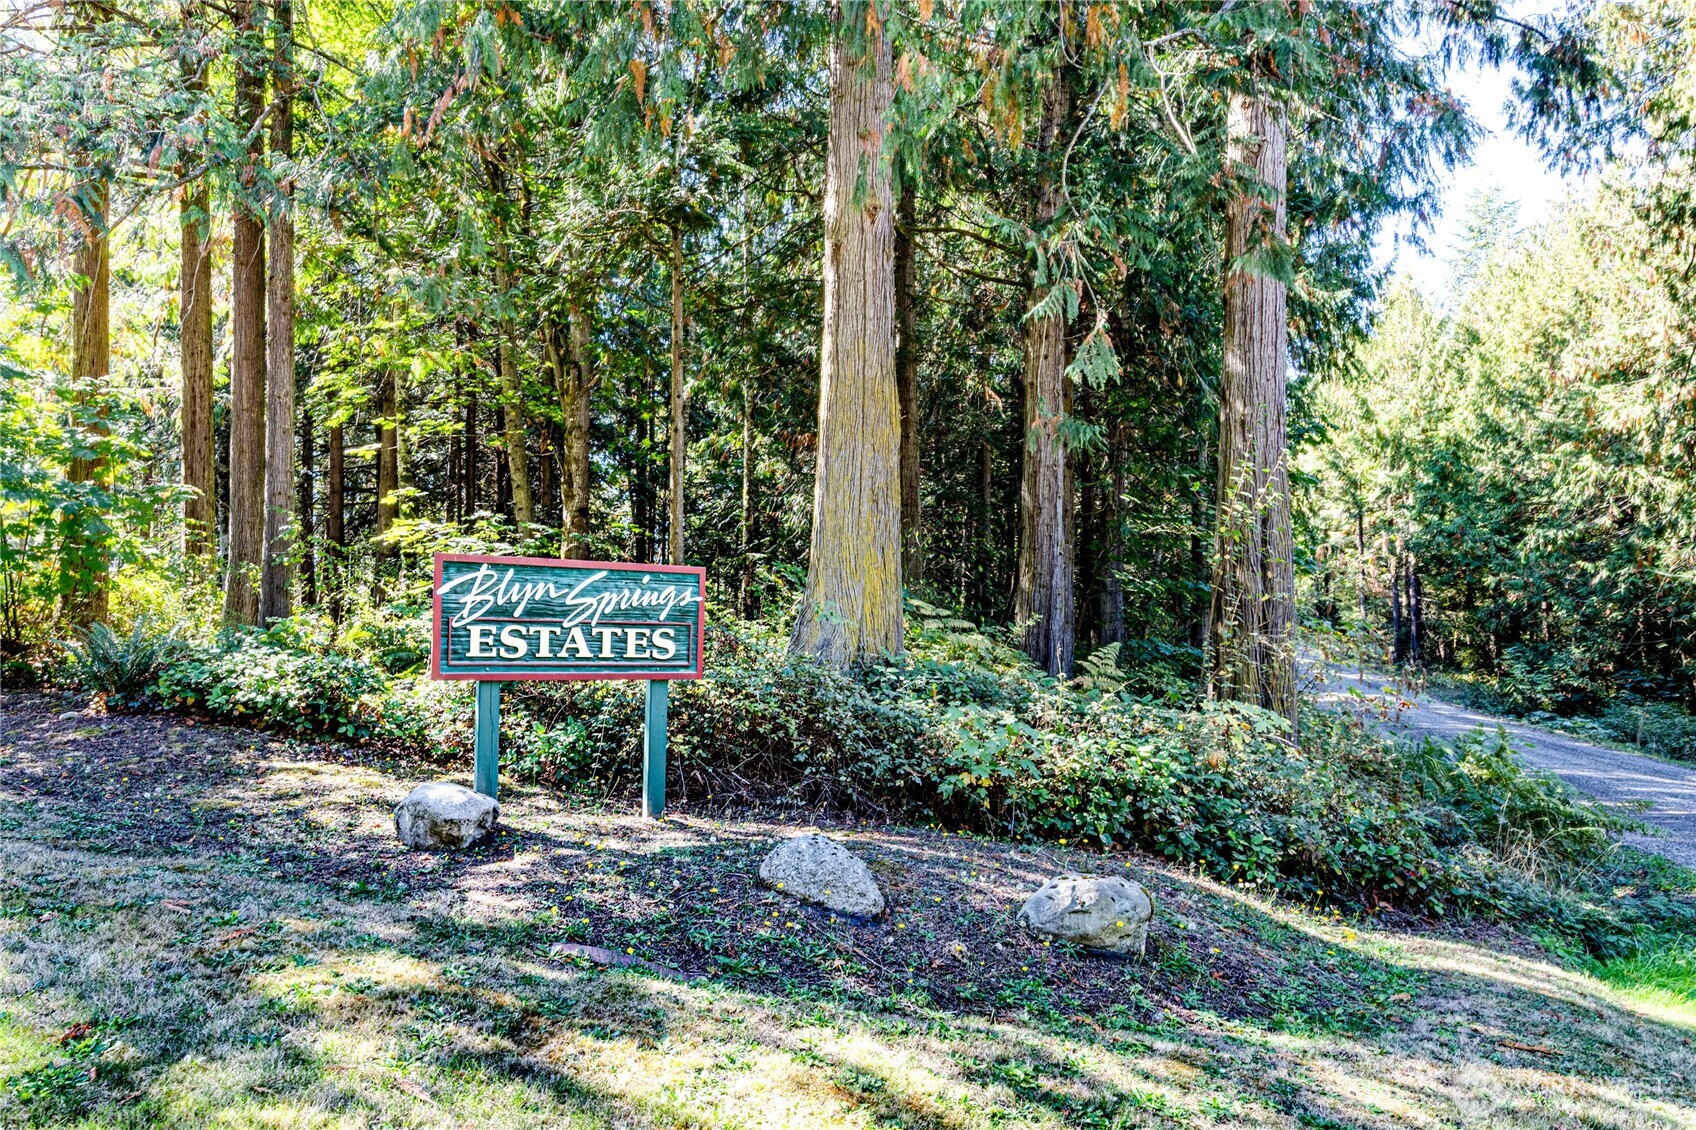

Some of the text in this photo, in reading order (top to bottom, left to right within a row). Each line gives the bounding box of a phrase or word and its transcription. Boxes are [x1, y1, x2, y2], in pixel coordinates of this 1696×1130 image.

[437, 563, 703, 628] Blyn Springs
[465, 625, 676, 660] ESTATES
